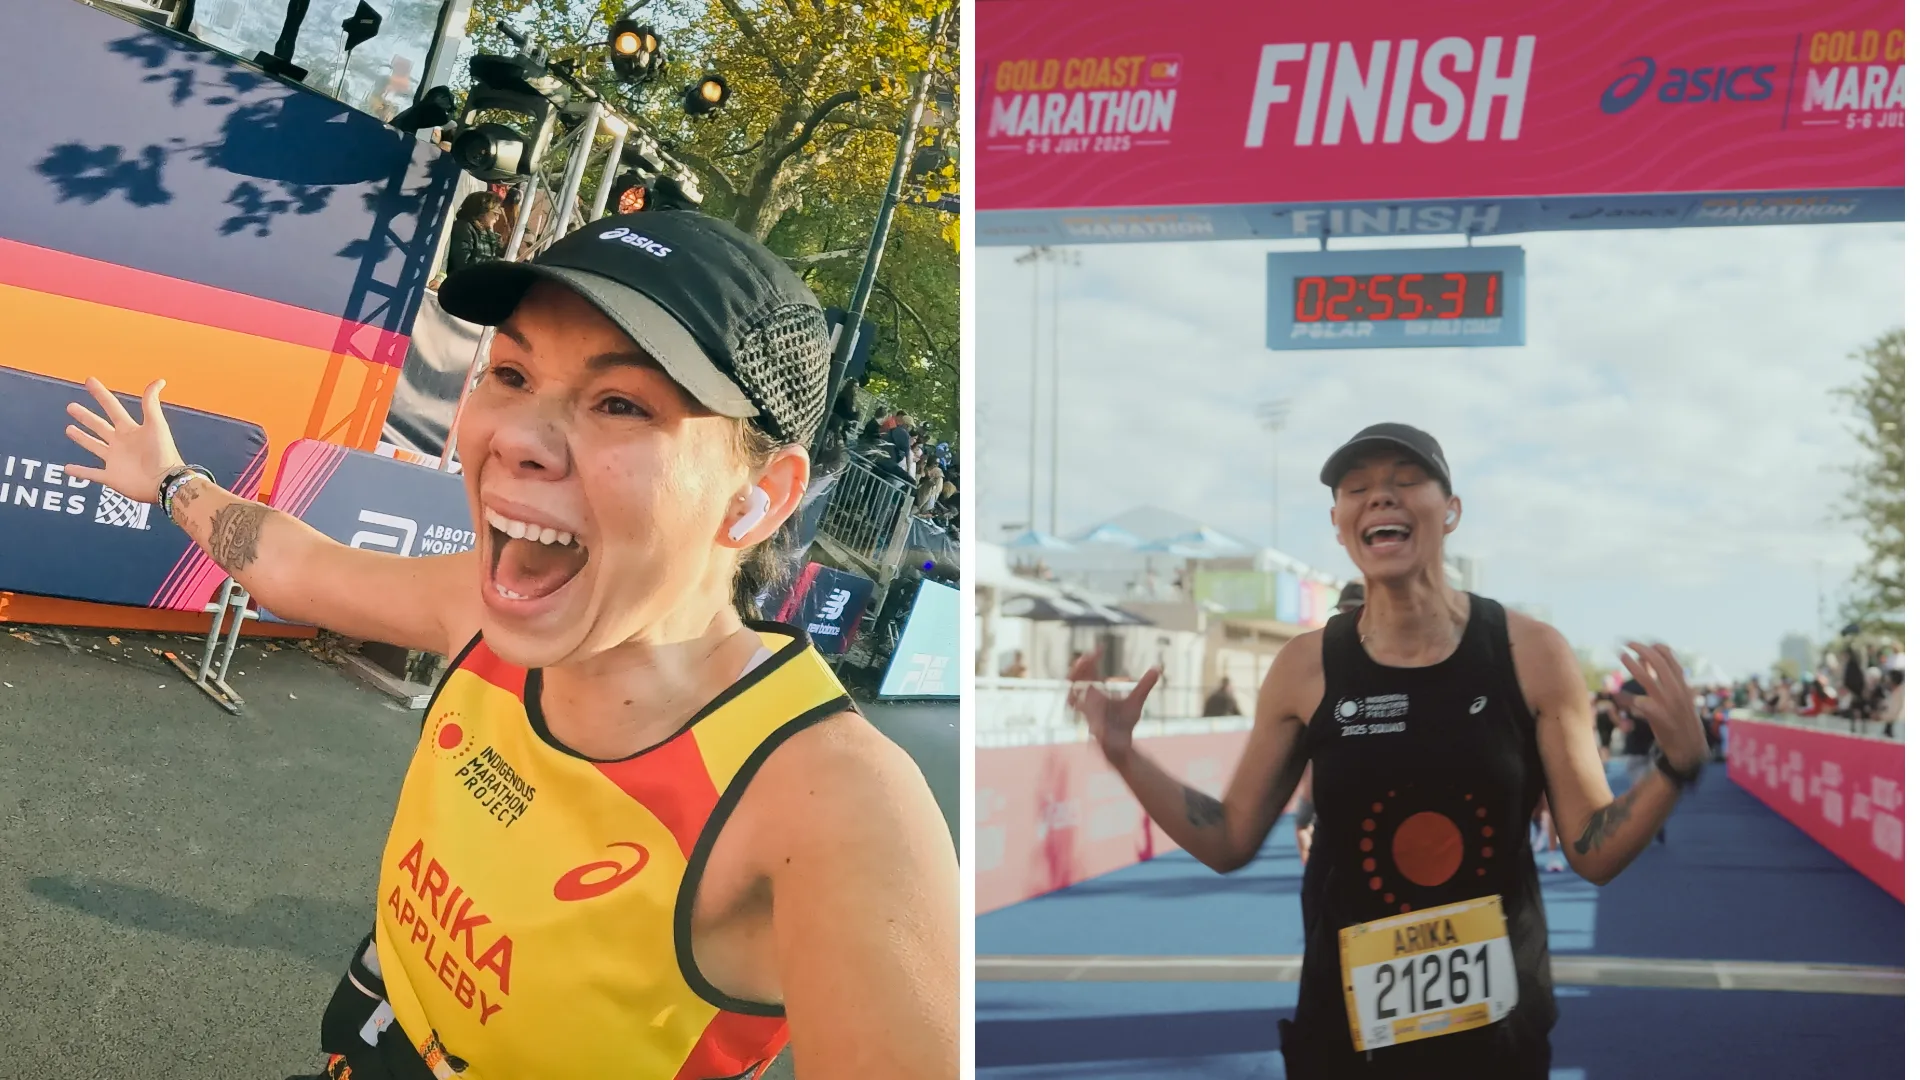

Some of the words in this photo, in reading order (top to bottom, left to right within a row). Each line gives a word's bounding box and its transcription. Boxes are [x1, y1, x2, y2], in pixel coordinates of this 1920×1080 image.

[1809, 29, 1879, 63] GOLD
[996, 59, 1060, 91] GOLD
[1063, 56, 1146, 89] COAST
[1244, 35, 1536, 147] FINISH
[1802, 65, 1905, 111] MARA
[988, 89, 1176, 137] MARATHON
[1055, 137, 1090, 153] JULY
[1292, 206, 1500, 233] FINISH
[1295, 273, 1498, 322] 02:55.31
[455, 767, 518, 828] PROJECT
[467, 757, 528, 817] MARATHON
[480, 746, 536, 802] INDIGENOUS
[398, 838, 513, 996] ARIKA
[1395, 919, 1459, 955] ARIKA
[388, 885, 502, 1026] APPLEBY
[1375, 944, 1491, 1020] 21261
